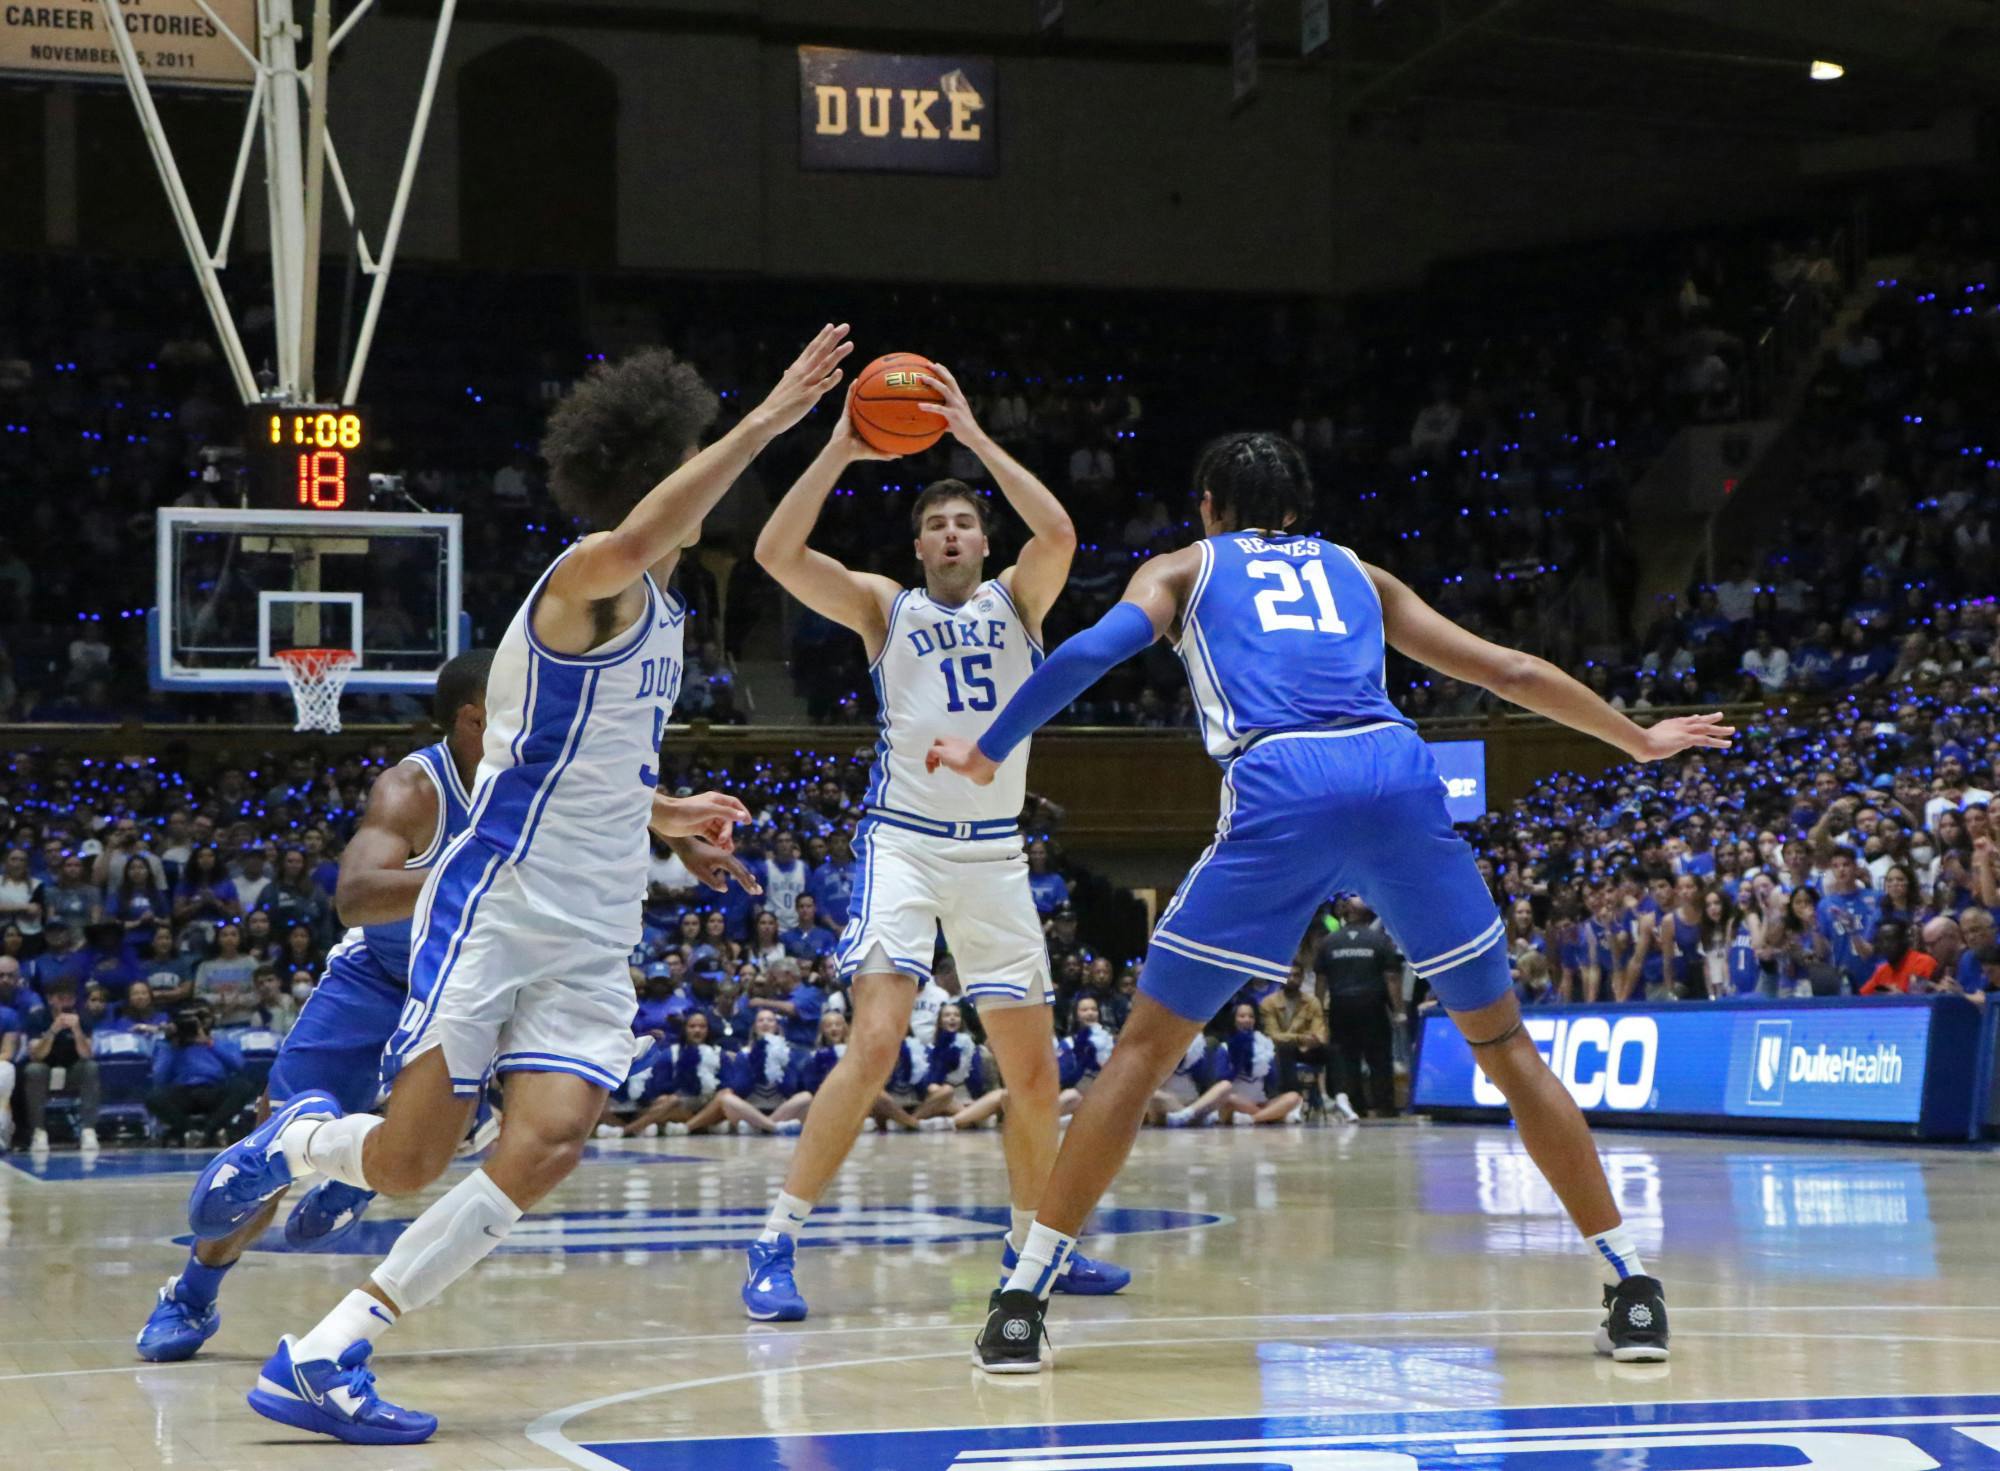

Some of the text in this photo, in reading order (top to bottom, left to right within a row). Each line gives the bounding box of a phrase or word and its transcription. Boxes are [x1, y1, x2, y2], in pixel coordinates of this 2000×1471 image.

[6, 6, 218, 37] CAREER CTORIES
[157, 52, 195, 67] 2011
[815, 84, 981, 140] DUKE
[270, 413, 361, 448] 11:08
[299, 450, 346, 508] 18
[1246, 559, 1348, 635] 21
[907, 619, 1007, 657] DUKE
[636, 657, 681, 701] DUK
[940, 653, 997, 712] 15
[1738, 949, 1746, 970] 1
[1788, 1043, 1903, 1085] DukeHealth
